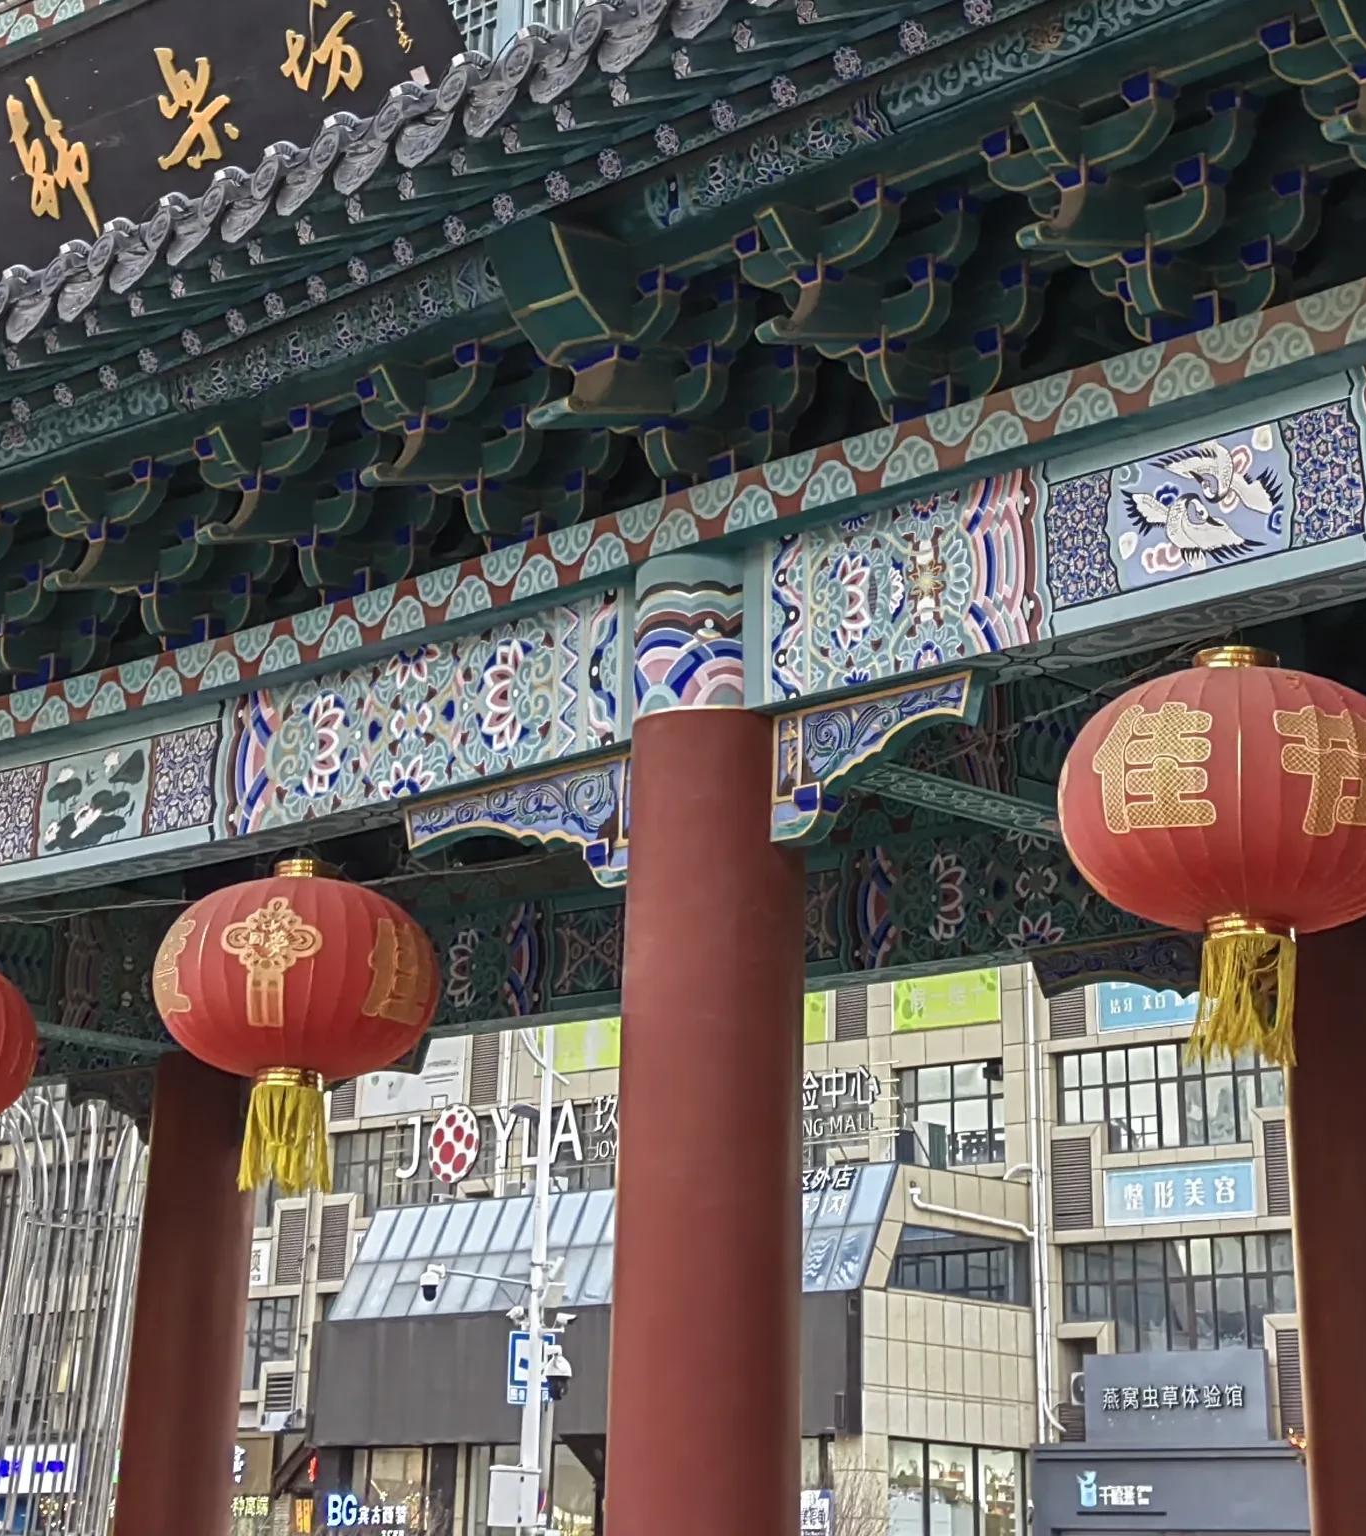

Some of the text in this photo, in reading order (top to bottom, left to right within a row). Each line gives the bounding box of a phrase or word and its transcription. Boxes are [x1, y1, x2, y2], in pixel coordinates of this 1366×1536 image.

[829, 1111, 878, 1134] MALL
[1123, 1175, 1235, 1211] 整形美容
[1102, 1384, 1244, 1411] 燕窝虫草体验馆
[327, 1494, 357, 1526] BG
